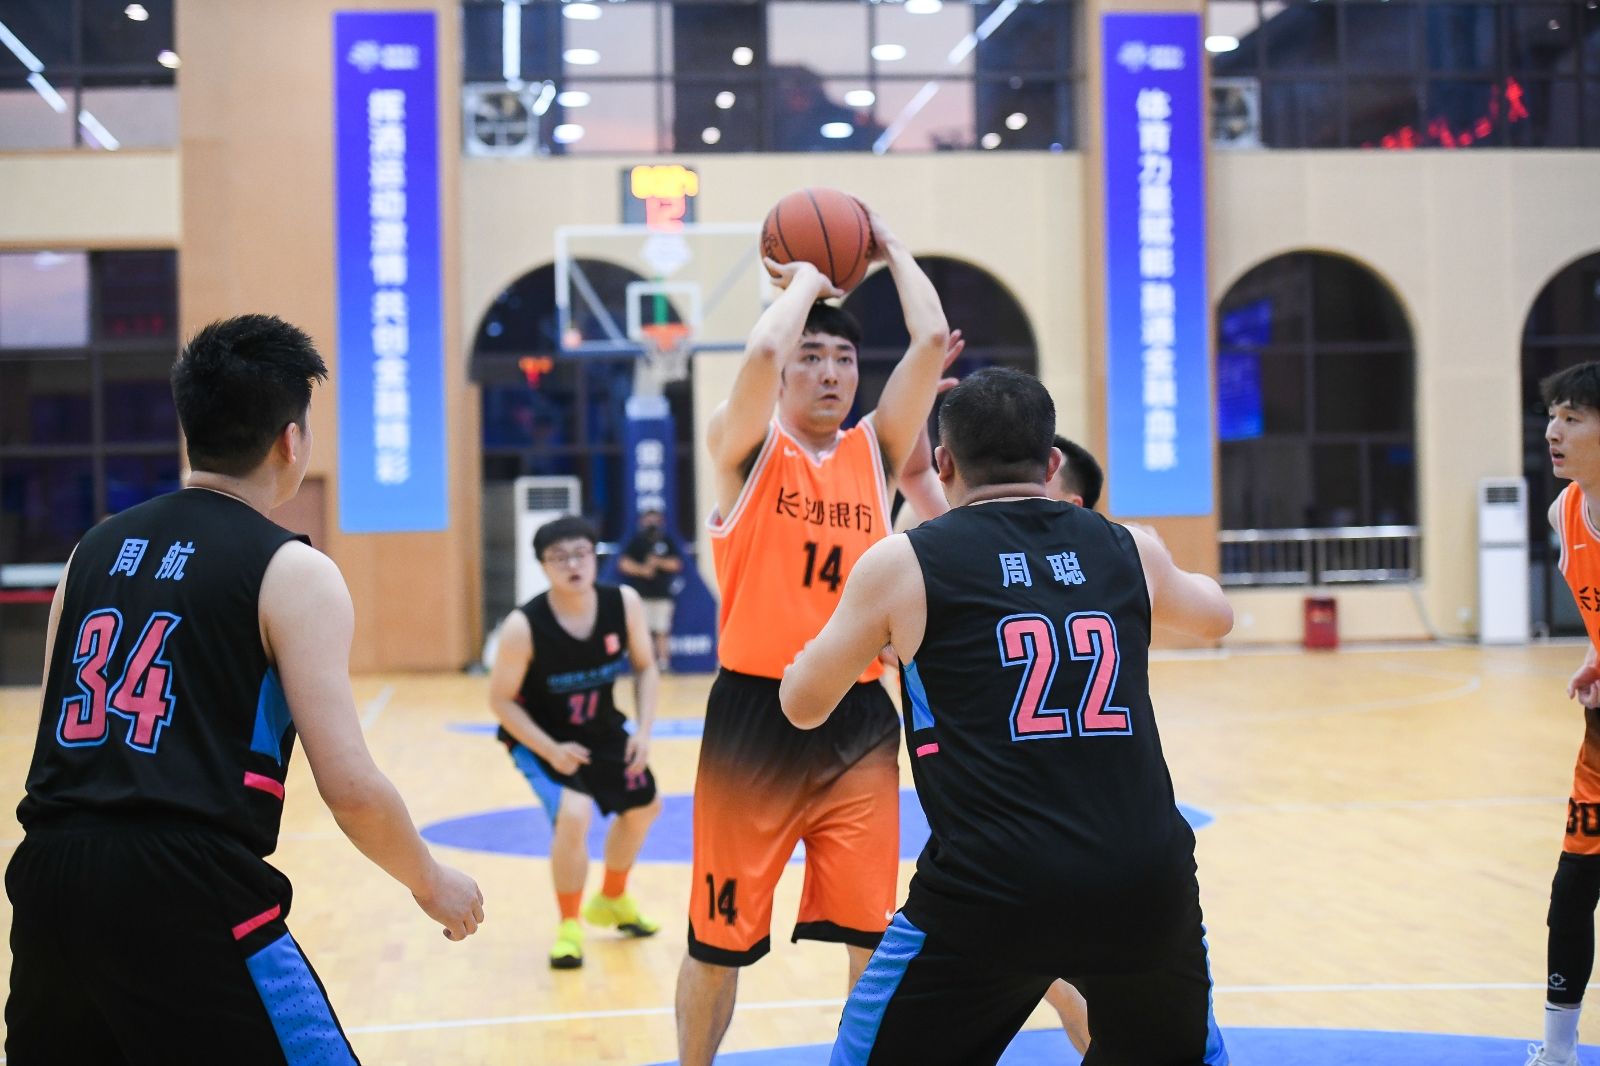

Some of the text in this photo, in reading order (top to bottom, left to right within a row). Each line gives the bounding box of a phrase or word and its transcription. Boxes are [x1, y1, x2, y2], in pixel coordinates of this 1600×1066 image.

[775, 486, 873, 534] 长沙银行
[108, 538, 196, 581] 周航
[802, 540, 844, 593] 14
[998, 551, 1087, 588] 周聪
[56, 607, 182, 754] 34
[996, 610, 1133, 742] 22
[705, 872, 739, 926] 14
